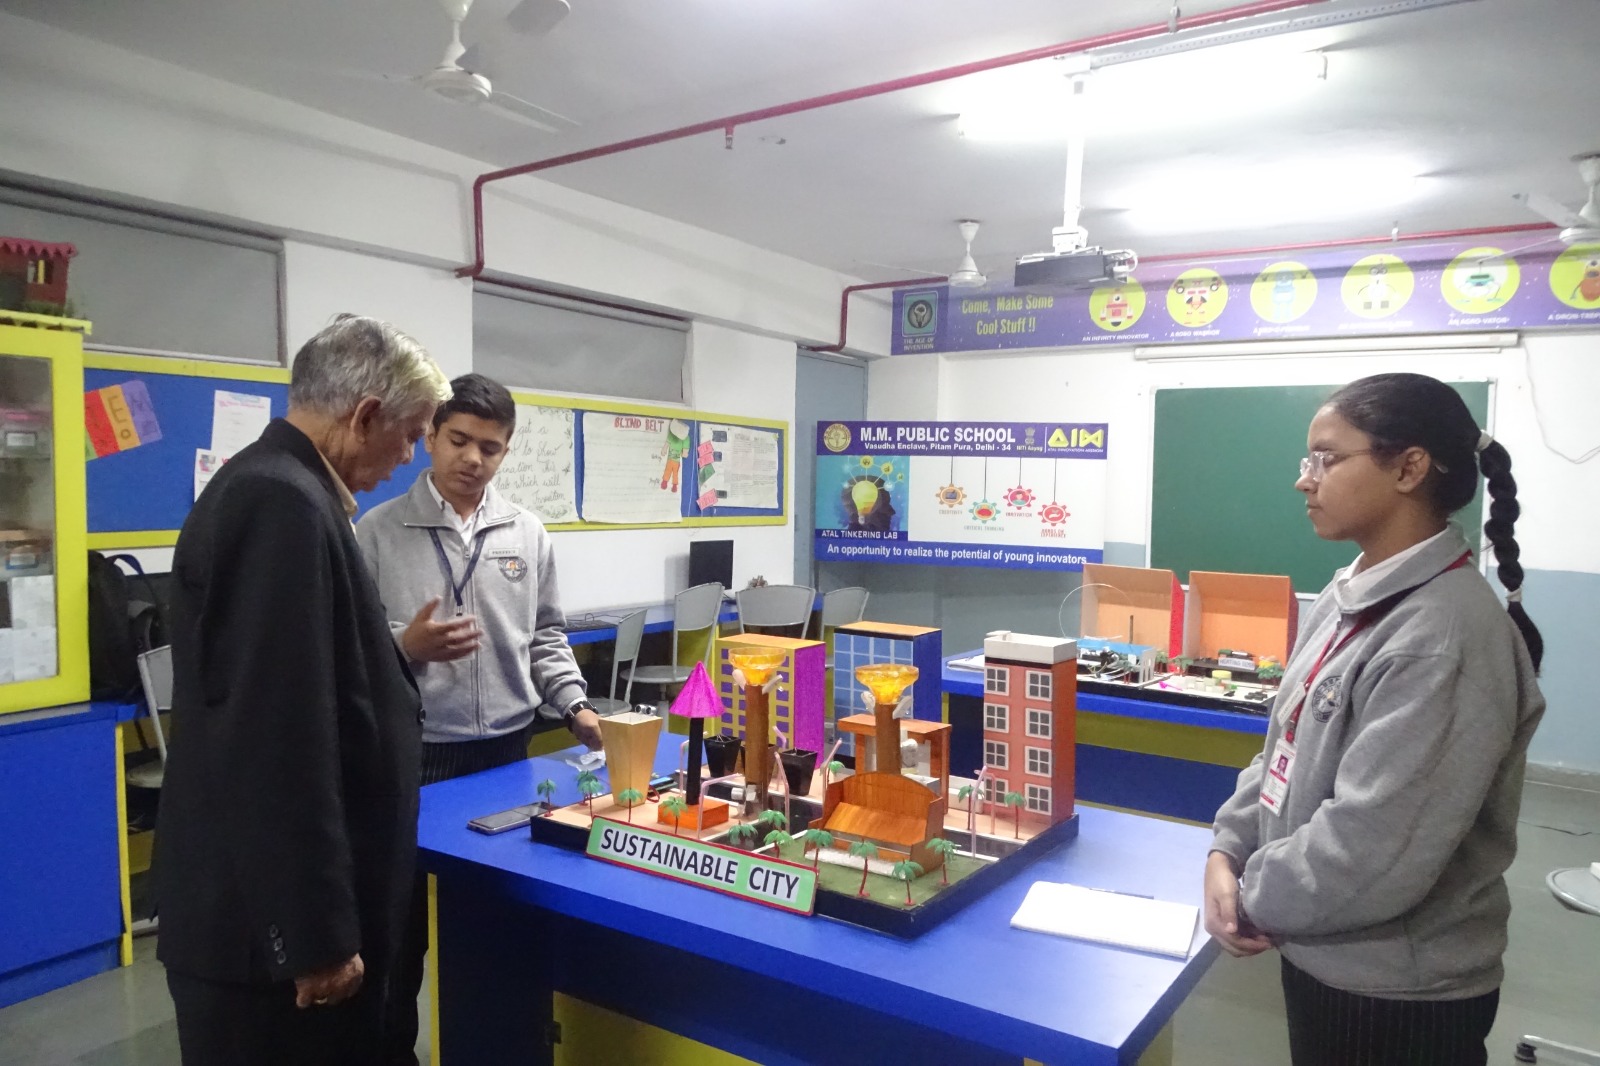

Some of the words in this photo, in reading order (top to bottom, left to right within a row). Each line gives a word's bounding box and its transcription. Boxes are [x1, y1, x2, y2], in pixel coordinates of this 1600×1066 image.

[962, 299, 991, 314] Come,
[997, 296, 1023, 311] Make
[1025, 294, 1054, 310] Some
[976, 318, 998, 335] Cool
[1000, 317, 1026, 334] Stuff
[1091, 334, 1116, 342] INFINITY
[904, 343, 934, 351] INVENTION
[614, 417, 641, 429] BLIND
[645, 418, 664, 433] BELT
[860, 427, 892, 442] M.M.
[897, 427, 950, 442] PUBLIC
[953, 427, 1015, 443] SCHOOL
[864, 442, 895, 450] Vasudha
[897, 442, 928, 451] Enclave,
[930, 442, 951, 450] Pitam
[954, 443, 973, 451] Pura,
[976, 443, 995, 451] Delhi
[1001, 443, 1011, 451] 34
[821, 530, 839, 538] ATAL
[841, 530, 881, 539] TINKERING
[883, 531, 898, 539] LAB
[827, 543, 839, 554] An
[841, 545, 891, 558] opportunity
[893, 546, 901, 556] to
[904, 547, 933, 557] realize
[935, 547, 949, 558] the
[951, 549, 991, 560] potential
[993, 550, 1003, 560] of
[1004, 552, 1034, 564] young
[1036, 552, 1087, 565] innovators
[601, 828, 739, 885] SUSTAINABLE
[749, 866, 800, 899] CITY
